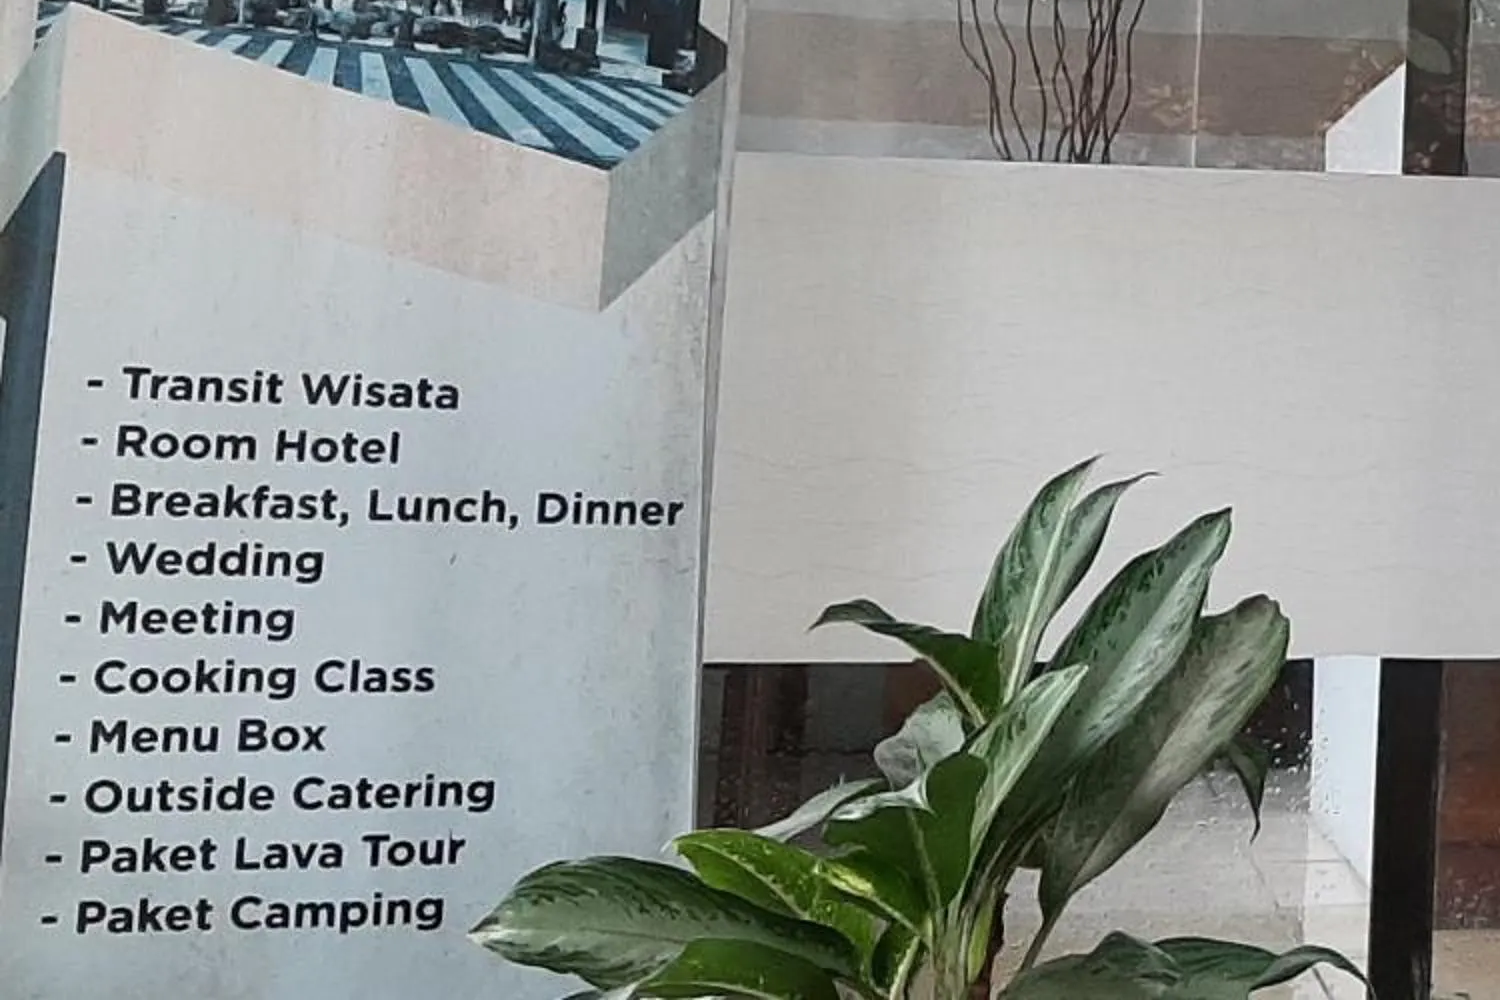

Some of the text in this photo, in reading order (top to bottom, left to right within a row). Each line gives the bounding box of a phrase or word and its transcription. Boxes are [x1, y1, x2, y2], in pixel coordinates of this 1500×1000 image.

[122, 366, 284, 405] Transit
[301, 373, 459, 410] Wisata
[117, 425, 257, 461] Room
[275, 429, 401, 464] Hotel
[111, 483, 349, 528] Breakfast,
[368, 489, 519, 530] Lunch,
[537, 491, 685, 527] Dinner
[106, 541, 324, 584] Wedding
[100, 600, 295, 642] Meeting
[94, 659, 296, 701] Cooking
[314, 659, 435, 693] Class
[90, 720, 219, 754] Menu
[237, 719, 326, 752] Box
[85, 776, 275, 814] Outside
[293, 774, 495, 813] Catering
[80, 837, 218, 874] Paket
[235, 836, 343, 871] Lava
[361, 834, 467, 867] Tour
[76, 897, 214, 935] Paket
[230, 892, 445, 935] Camping
